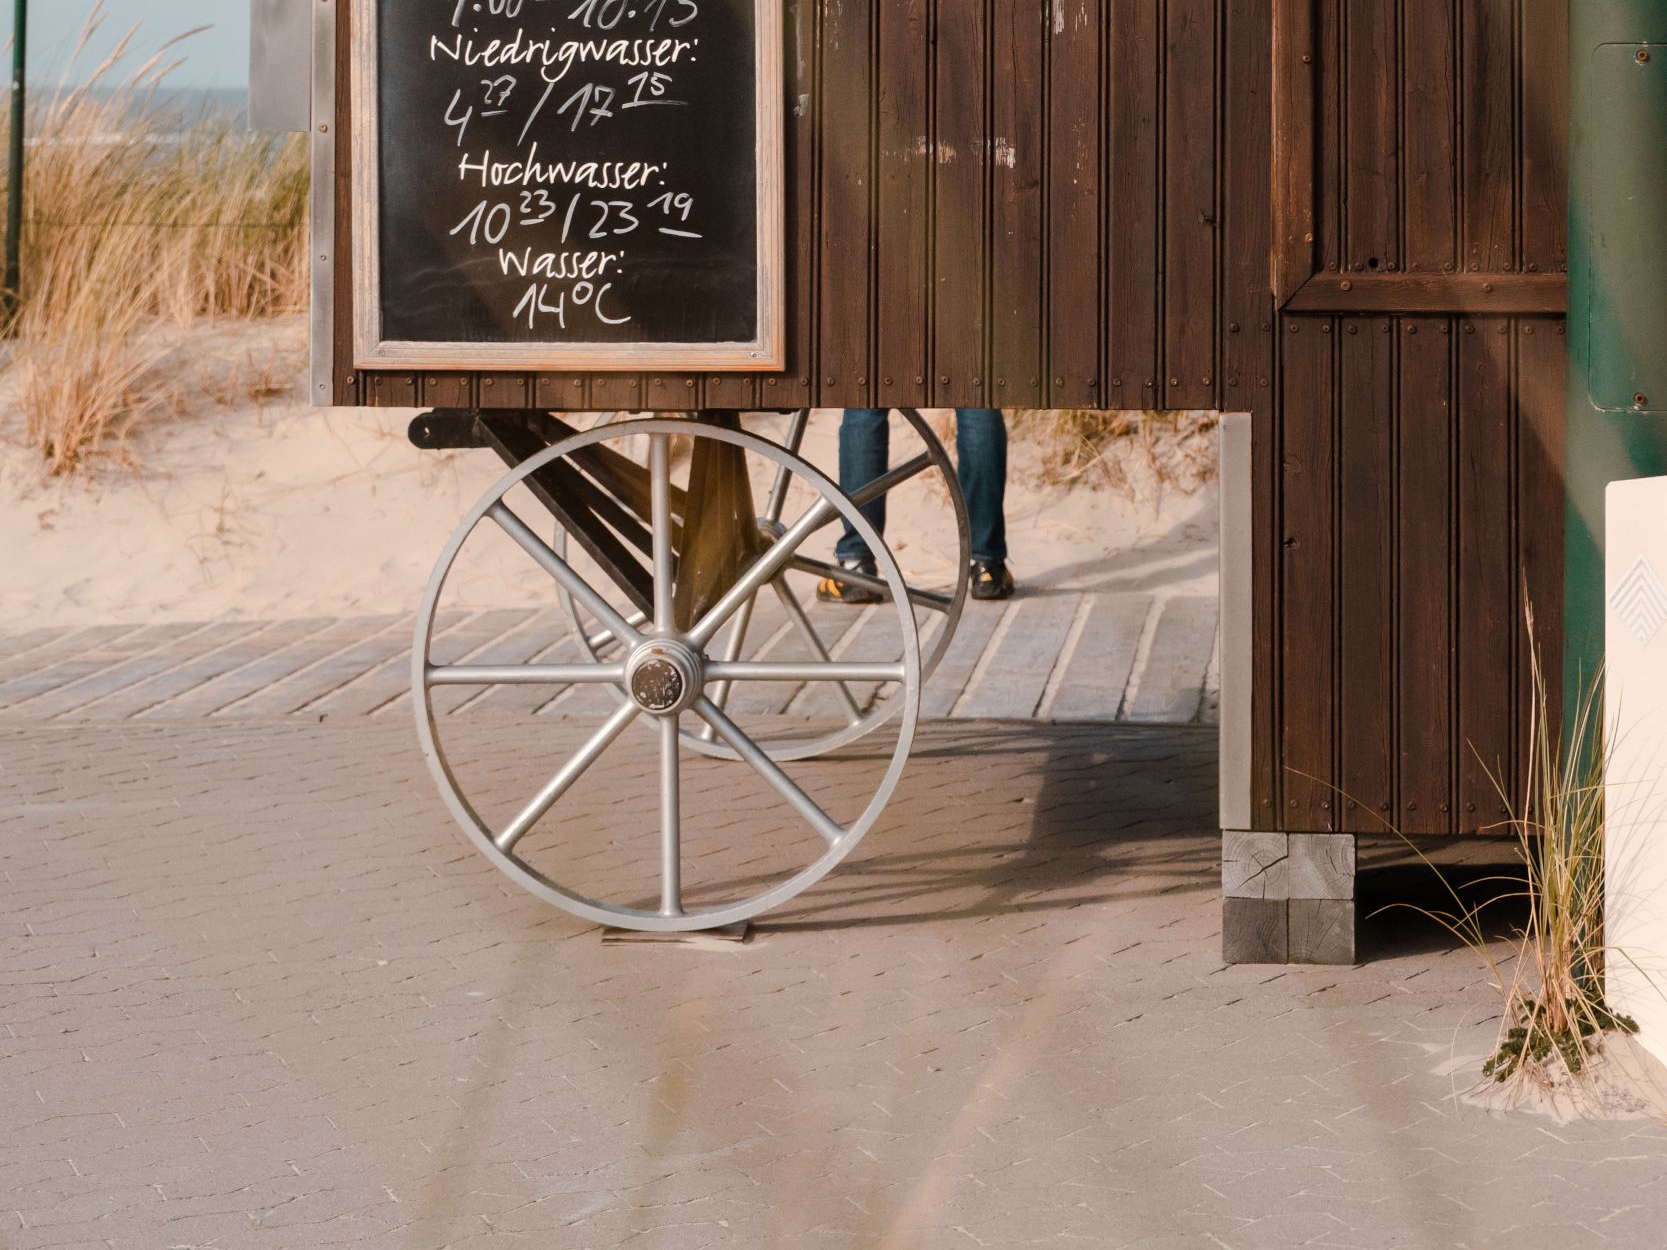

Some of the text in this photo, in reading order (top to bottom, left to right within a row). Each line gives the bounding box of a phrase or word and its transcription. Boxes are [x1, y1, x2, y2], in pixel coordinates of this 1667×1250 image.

[430, 27, 698, 83] Niedrigwasser:
[457, 141, 668, 188] Hochwasser:
[498, 249, 625, 279] Wasser:
